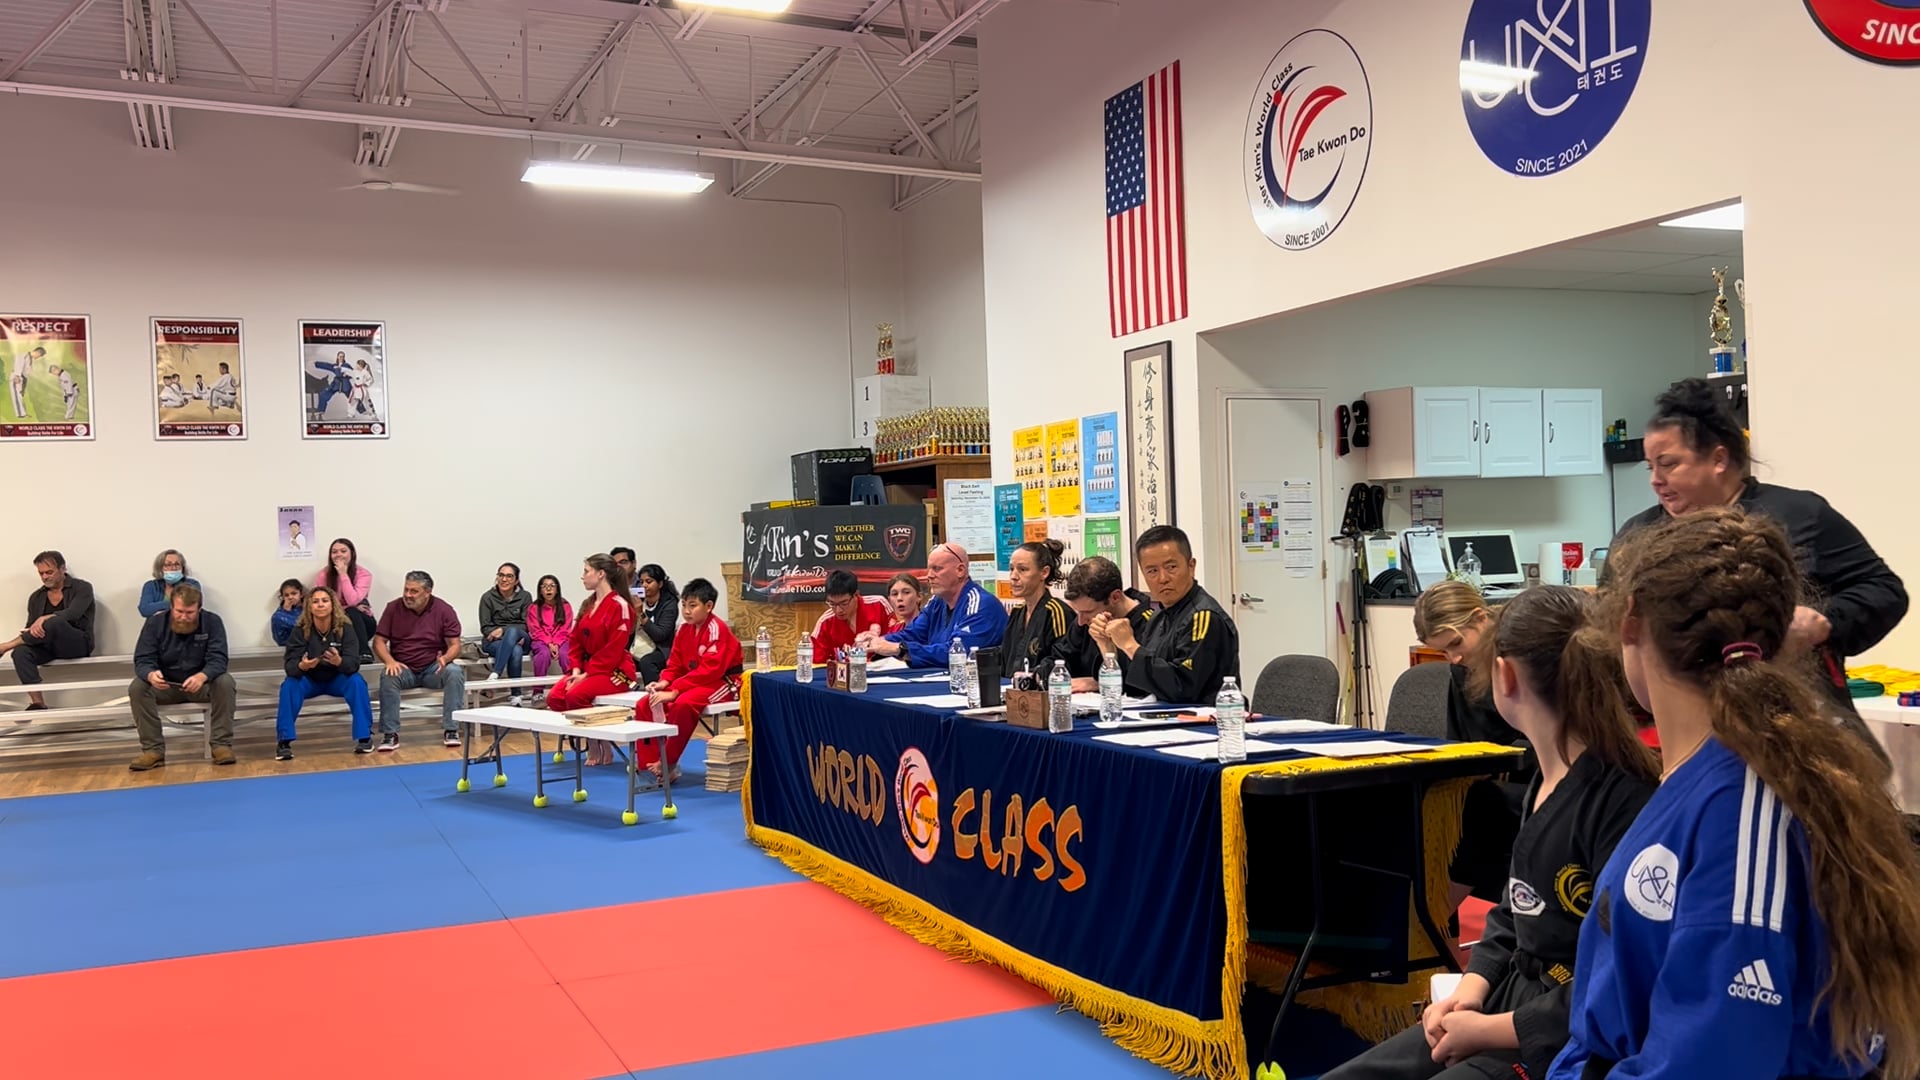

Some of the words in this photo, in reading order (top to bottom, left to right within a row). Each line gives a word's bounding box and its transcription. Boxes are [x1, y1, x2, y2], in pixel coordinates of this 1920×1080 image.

[1271, 62, 1294, 91] Class
[1255, 92, 1273, 137] World
[1298, 147, 1314, 163] Tae
[1317, 133, 1347, 154] Kwon
[1350, 126, 1366, 143] Do
[1254, 143, 1263, 182] Kim's
[1515, 156, 1556, 173] SINCE
[1558, 139, 1588, 167] 2021
[1284, 233, 1309, 246] SINCE
[1311, 221, 1330, 242] 2001
[12, 321, 71, 332] RESPECT
[158, 325, 238, 335] RESPONSIBILITY
[313, 328, 372, 337] LEADERSHIP
[864, 385, 870, 401] 1
[863, 421, 869, 436] 3
[834, 524, 875, 533] TOGETHER
[834, 534, 846, 542] WE
[848, 533, 864, 541] CAN
[858, 543, 863, 551] A
[834, 552, 880, 561] DIFFERENCE
[806, 741, 886, 827] WORLD
[952, 787, 1087, 892] CLASS
[1727, 983, 1783, 1005] adidas
